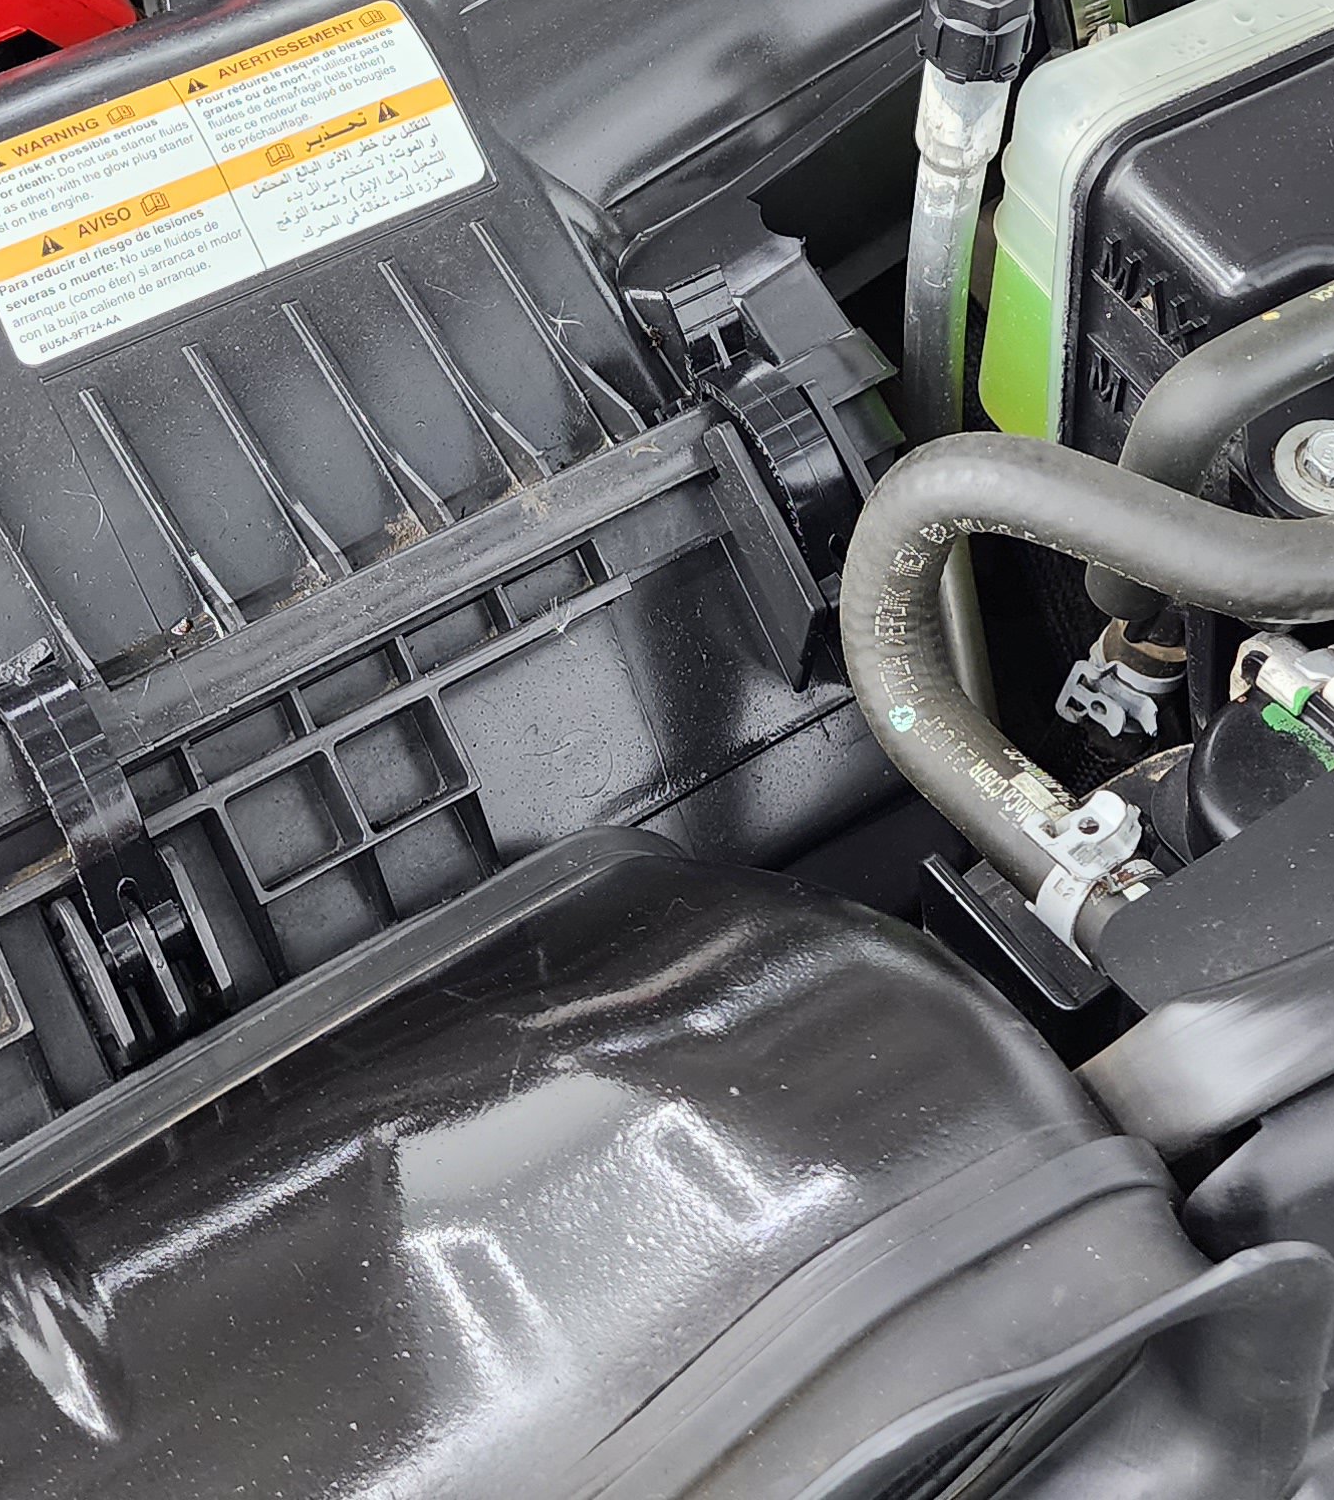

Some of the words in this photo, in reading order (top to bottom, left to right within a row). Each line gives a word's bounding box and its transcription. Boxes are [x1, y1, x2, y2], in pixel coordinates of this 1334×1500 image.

[194, 91, 224, 107] Pour
[269, 70, 282, 79] le
[282, 55, 320, 74] risque
[321, 48, 336, 58] de
[337, 27, 393, 52] blessures
[202, 97, 243, 120] graves
[244, 90, 261, 101] ou
[262, 84, 278, 95] de
[358, 44, 380, 59] pas
[380, 38, 395, 49] de
[218, 18, 354, 80] AVERTISSEMENT
[11, 117, 99, 157] WARNING
[207, 109, 245, 130] fluides
[246, 103, 262, 115] de
[214, 125, 242, 141] avec
[243, 119, 258, 130] ce
[259, 102, 297, 124] moteur
[337, 81, 353, 92] de
[352, 64, 397, 86] bougies
[220, 142, 236, 153] de
[237, 112, 312, 149] préchauffage.
[0, 188, 12, 199] or
[15, 172, 56, 193] death:
[56, 165, 75, 177] Do
[76, 156, 96, 170] not
[96, 148, 119, 162] use
[120, 132, 156, 153] starter
[158, 121, 189, 138] fluids
[2, 203, 18, 214] as
[19, 186, 55, 208] ether)
[55, 178, 81, 193] with
[81, 170, 101, 183] the
[102, 158, 129, 177] glow
[131, 148, 158, 166] plug
[157, 133, 194, 154] starter
[17, 162, 42, 177] risk
[43, 154, 57, 166] of
[58, 136, 111, 163] possible
[112, 118, 158, 140] serious
[10, 215, 27, 228] on
[27, 207, 48, 221] the
[50, 191, 94, 212] engine.
[30, 259, 75, 284] reducir
[78, 251, 91, 264] el
[92, 237, 132, 259] riesgo
[134, 230, 151, 242] de
[151, 208, 204, 235] lesiones
[78, 206, 131, 238] AVISO
[5, 286, 56, 312] severas
[57, 281, 67, 291] o
[69, 261, 118, 286] muerte:
[119, 253, 138, 266] No
[139, 243, 162, 258] use
[162, 227, 202, 249] fluidos
[203, 220, 219, 233] de
[11, 300, 67, 328] arranque
[68, 284, 106, 307] (como
[107, 270, 136, 289] éter)
[137, 264, 149, 277] si
[150, 248, 195, 272] arranca
[196, 241, 208, 253] el
[209, 228, 242, 248] motor
[18, 328, 43, 344] con
[42, 323, 57, 334] la
[89, 290, 136, 315] caliente
[137, 283, 153, 295] de
[155, 261, 211, 288] arranque.
[38, 314, 122, 354] BU5A-9F724-AA
